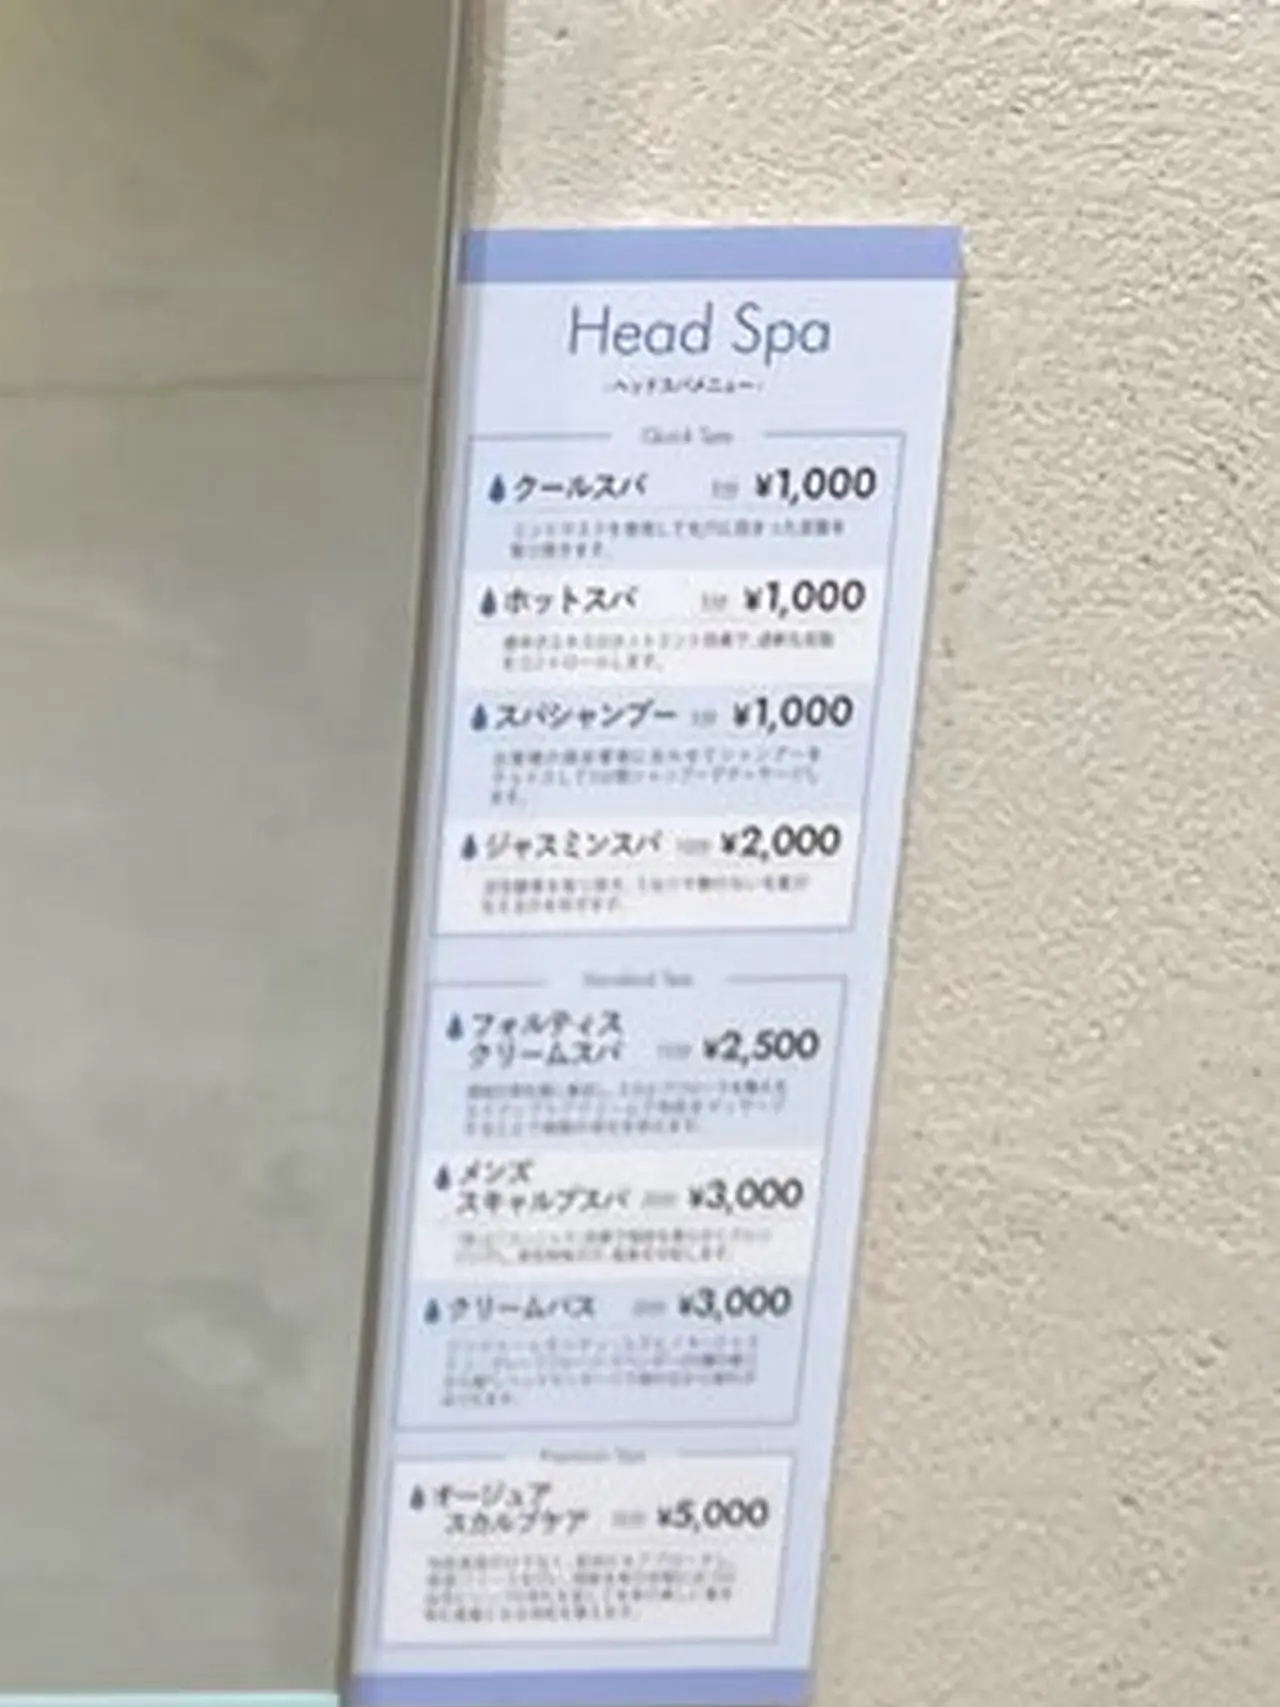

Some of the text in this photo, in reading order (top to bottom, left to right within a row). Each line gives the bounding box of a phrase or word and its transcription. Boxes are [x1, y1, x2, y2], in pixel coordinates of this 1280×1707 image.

[569, 300, 831, 367] Head Spa
[755, 465, 877, 506] ¥1,000
[743, 579, 866, 619] ¥1,000
[733, 694, 854, 734] ¥1,000
[720, 823, 841, 863] ¥2,000
[703, 1028, 820, 1067] ¥2,500
[688, 1178, 804, 1215] ¥3,000
[678, 1286, 792, 1323] ¥3,000
[656, 1497, 770, 1533] ¥5,000
